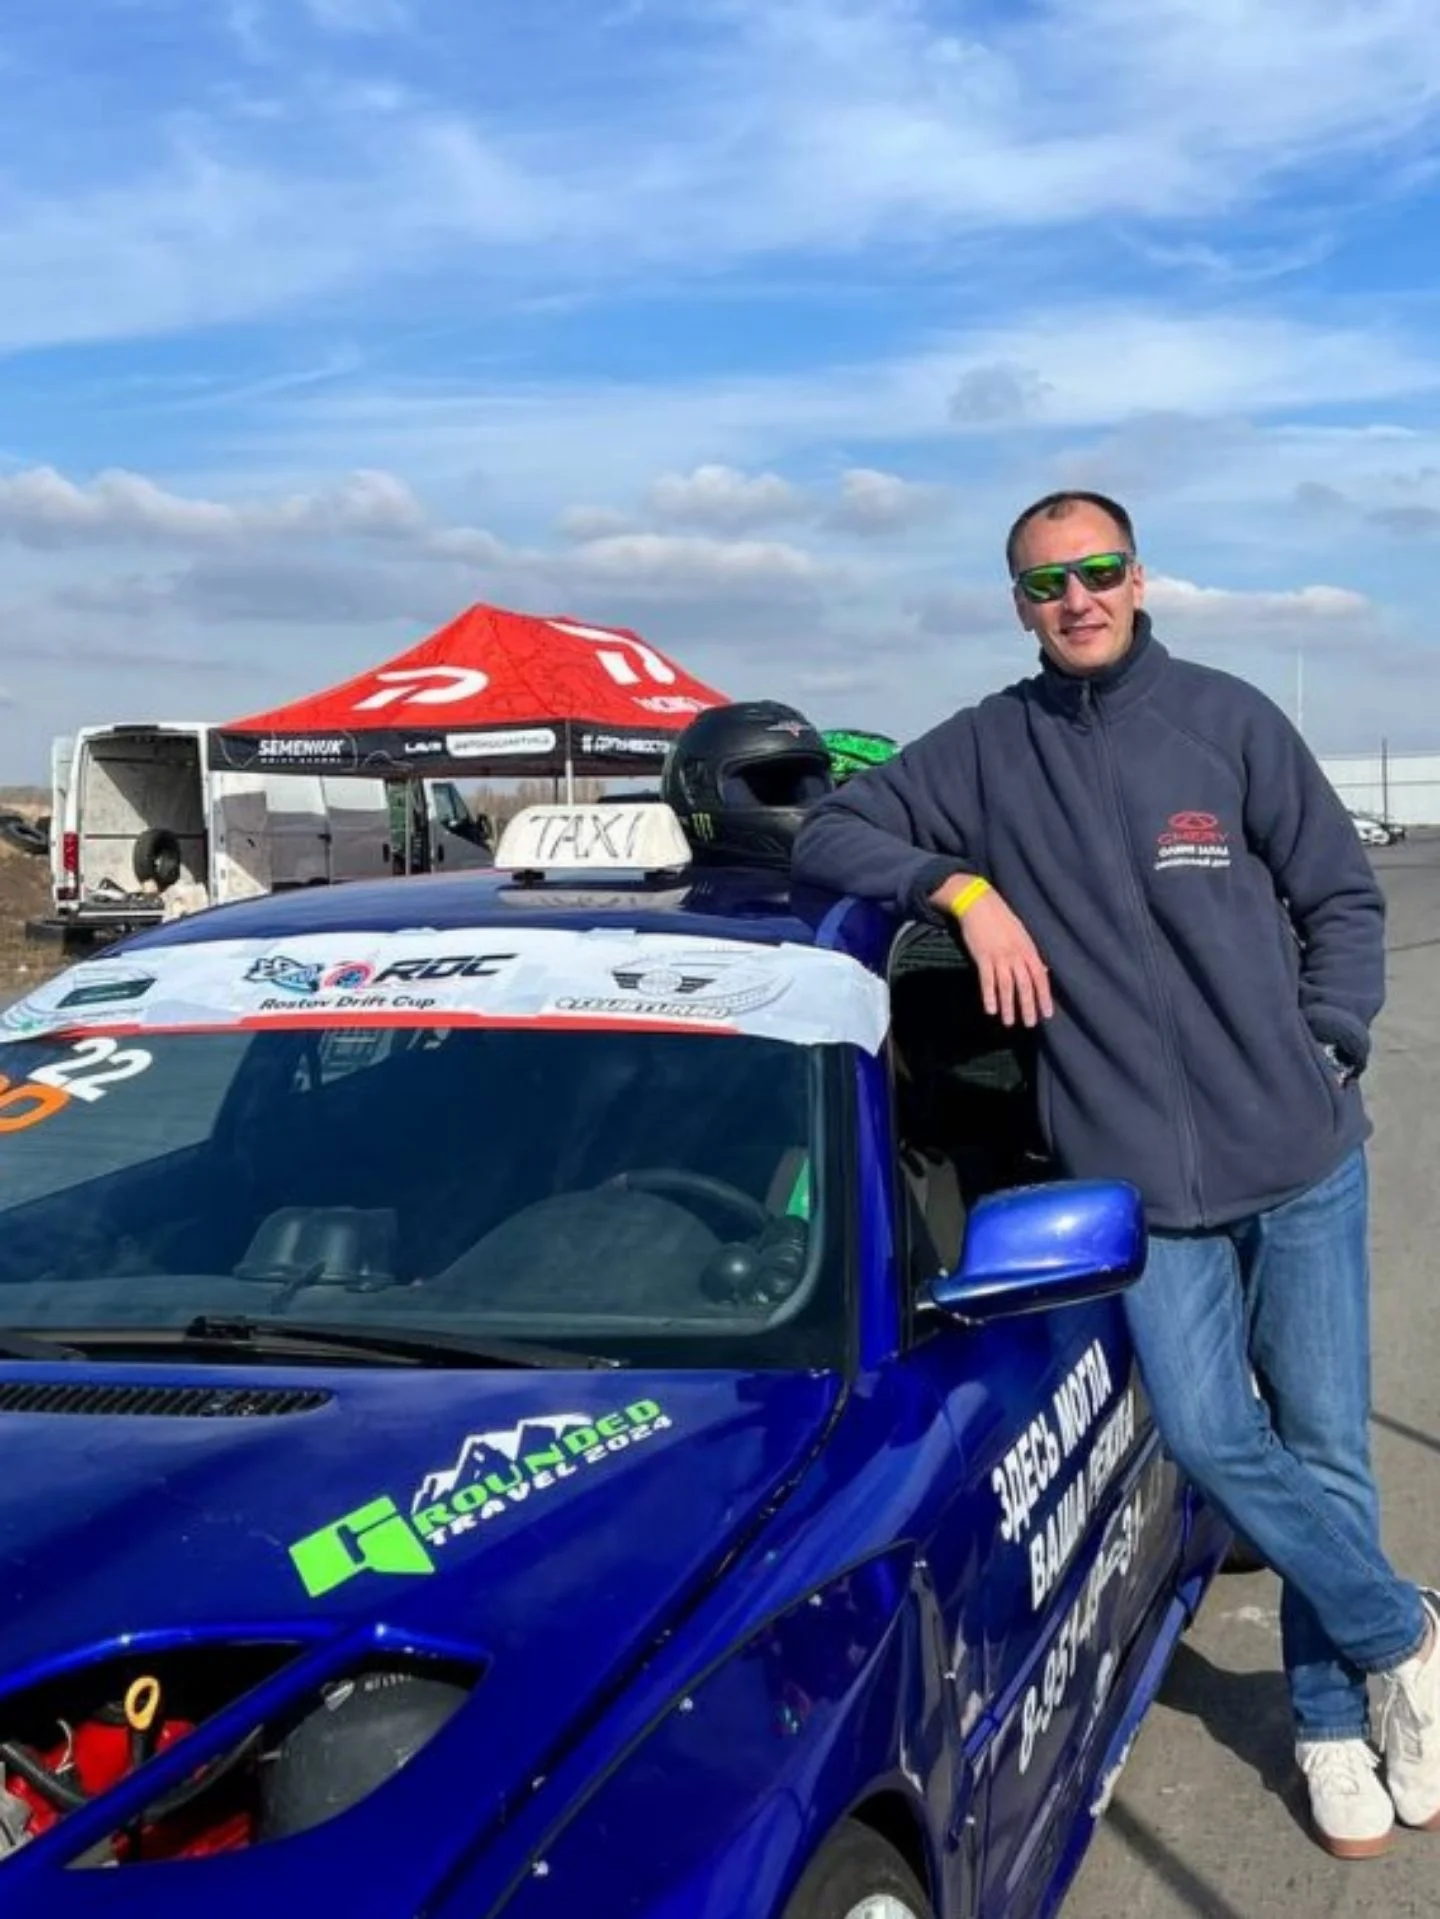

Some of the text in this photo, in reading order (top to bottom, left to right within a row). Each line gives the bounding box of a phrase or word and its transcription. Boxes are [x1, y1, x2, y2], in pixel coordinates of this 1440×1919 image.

[529, 811, 645, 860] TAXI
[259, 994, 436, 1011] Rostov Drift Cup
[27, 1036, 153, 1102] 22
[427, 1413, 673, 1547] TRAVEL 2024
[991, 1411, 1061, 1543] ЗДЕСЬ
[1029, 1469, 1086, 1612] ВАША
